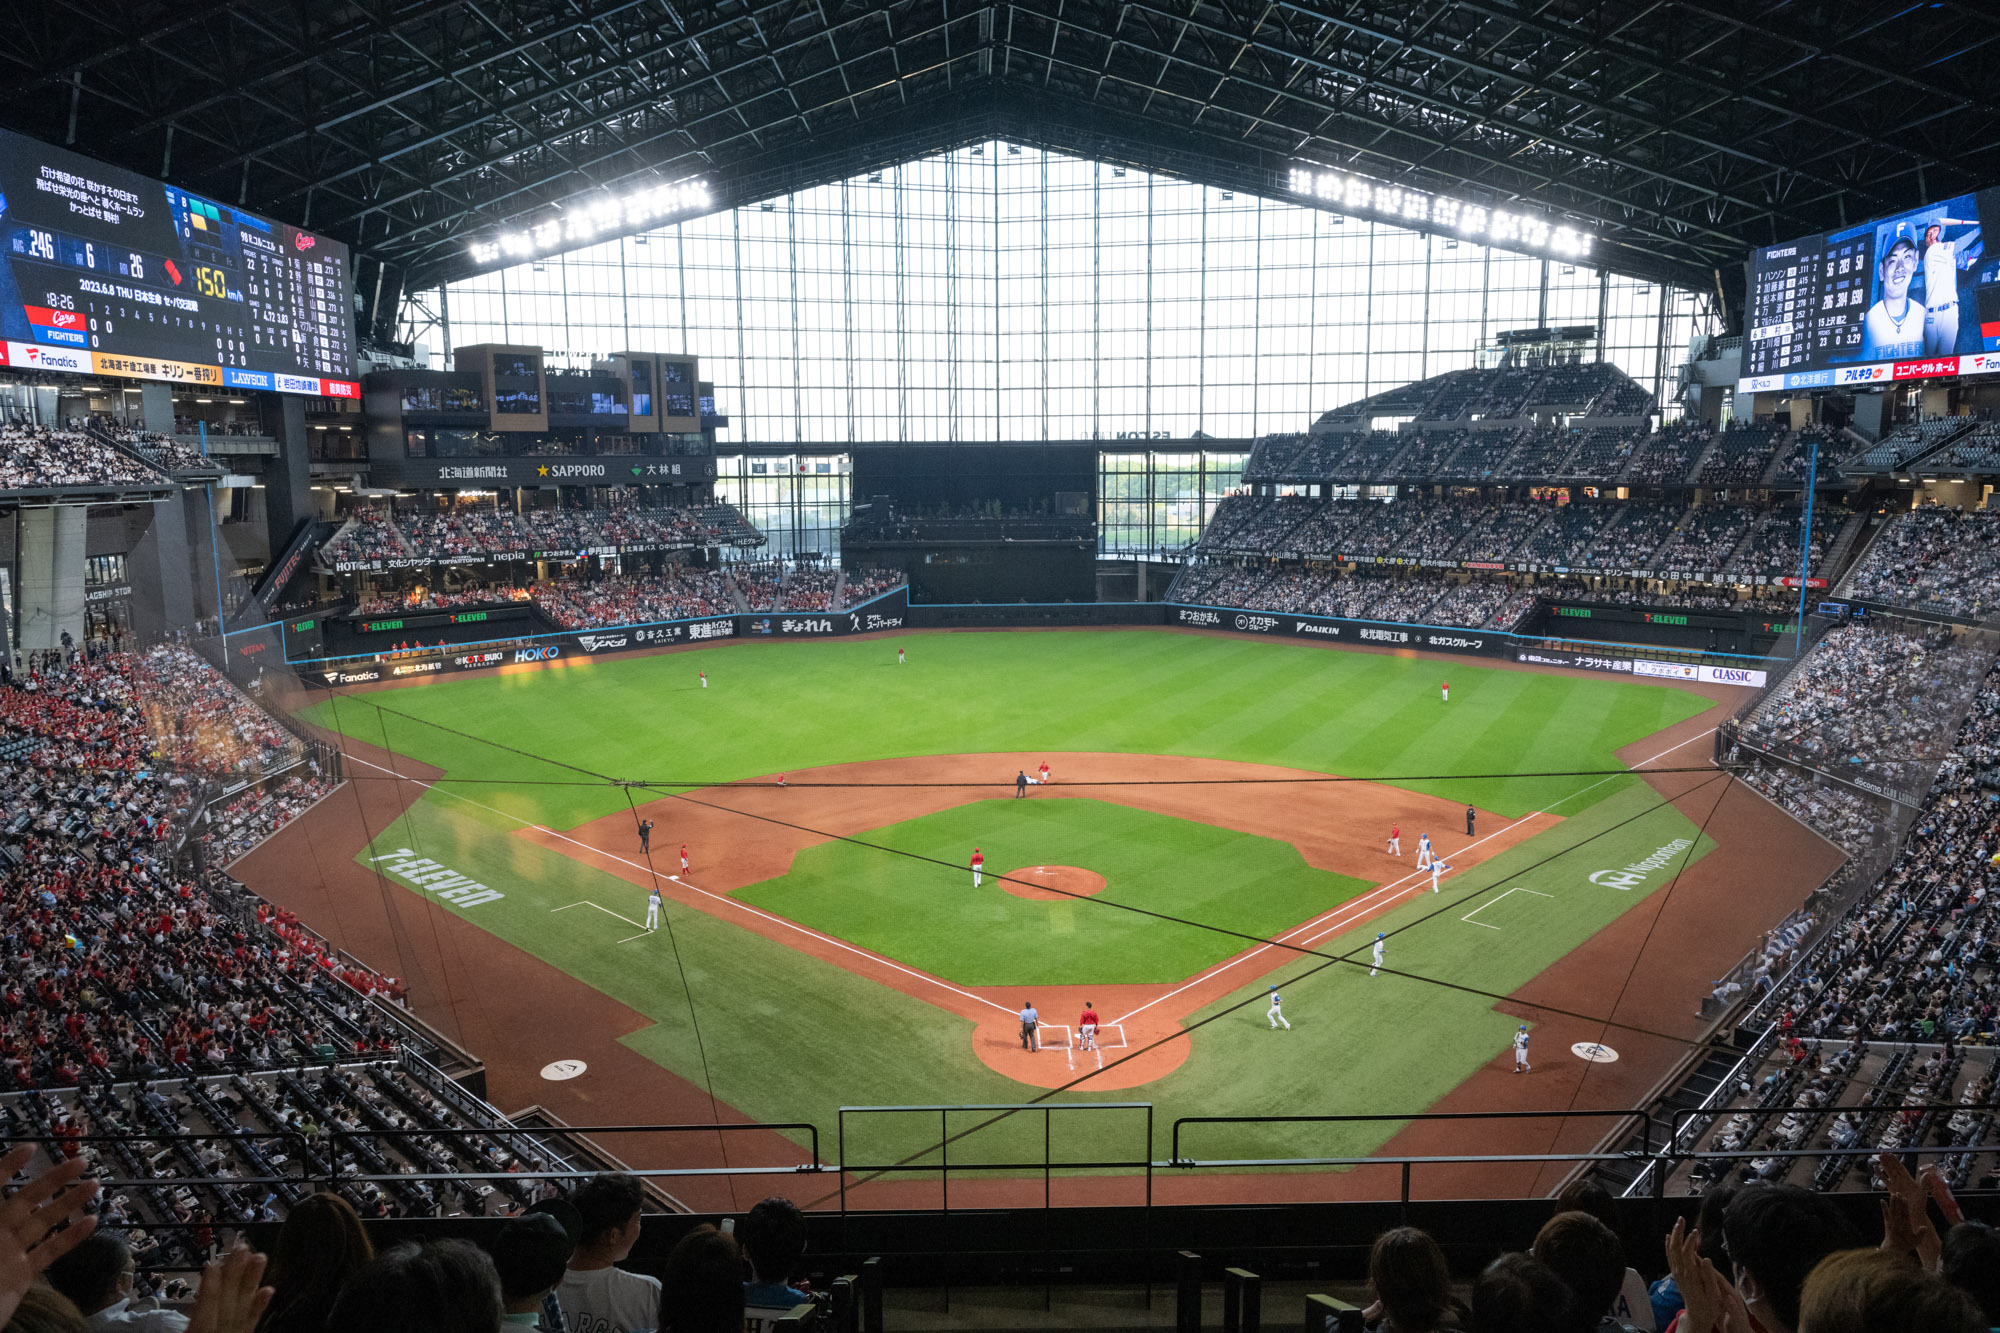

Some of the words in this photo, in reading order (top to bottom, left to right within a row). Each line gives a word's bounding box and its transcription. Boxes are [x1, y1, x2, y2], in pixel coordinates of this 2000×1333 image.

[182, 196, 187, 207] B
[183, 212, 188, 222] S
[1896, 222, 1906, 237] F
[241, 231, 248, 243] 98
[296, 233, 315, 252] Carp
[29, 230, 54, 260] .246
[86, 243, 94, 268] 6
[1766, 247, 1797, 260] FIGHTERS
[130, 254, 144, 279] 26
[247, 258, 255, 270] 22
[263, 263, 267, 274] 2
[275, 267, 282, 278] 12
[196, 266, 226, 299] 150
[227, 289, 244, 302] km/h
[79, 279, 115, 296] 2023.6.8
[116, 286, 133, 299] THU
[134, 289, 162, 305] 日本生命
[265, 287, 270, 298] 0
[278, 290, 283, 301] 0
[46, 292, 75, 310] 18:26
[52, 311, 76, 327] Carp
[105, 305, 110, 315] 2
[120, 308, 125, 317] 3
[134, 311, 140, 320] 4
[149, 313, 154, 322] 5
[163, 315, 167, 325] 6
[176, 318, 180, 327] 7
[188, 320, 194, 329] 8
[202, 322, 206, 331] 9
[227, 326, 232, 335] H
[1818, 318, 1824, 327] 15
[48, 330, 84, 343] FIGHTERS
[90, 318, 97, 331] 0
[106, 321, 113, 334] 0
[217, 338, 222, 349] 0
[228, 340, 234, 351] 0
[240, 341, 245, 352] 0
[255, 334, 260, 344] 0
[1820, 337, 1827, 347] 23
[1847, 334, 1861, 344] 3.29
[92, 335, 99, 348] 0
[218, 352, 223, 363] 0
[230, 354, 235, 365] 2
[241, 355, 246, 366] 0
[41, 353, 78, 368] Fanatics
[100, 358, 157, 374] 北海道千歳工場産
[232, 372, 268, 387] LAWSON
[1800, 373, 1828, 385] 北洋銀行
[1844, 368, 1872, 381] アルキタ
[438, 466, 508, 479] 北海道新聞社
[552, 464, 605, 477] SAPPORO
[646, 464, 681, 475] 大林組
[626, 544, 655, 552] 北海道バス
[1269, 549, 1298, 559] 小山商会
[493, 551, 525, 562] nepia
[274, 550, 300, 590] FUJITEC
[1518, 564, 1548, 573] 関電工
[1603, 568, 1654, 578] キリン一番搾り
[1670, 572, 1705, 582] 田中組
[1712, 574, 1767, 584] 旭東清掃
[867, 618, 902, 629] スーパードライ
[1179, 610, 1220, 624] まつおかまん
[1248, 616, 1279, 627] オカモト
[689, 622, 712, 639] 東進
[782, 619, 832, 632] ぎょれん
[1305, 624, 1339, 635] DAIKIN
[1360, 628, 1408, 643] 東光電気工事
[1429, 636, 1483, 648] 北ガスグループ
[462, 652, 503, 663] KOTOBUKI
[514, 646, 559, 663] HOKKO
[1575, 656, 1632, 671] ナラサキ産業
[339, 671, 379, 683] Fanatics
[1712, 668, 1751, 682] CLASSIC
[1624, 838, 1693, 874] Nipponham
